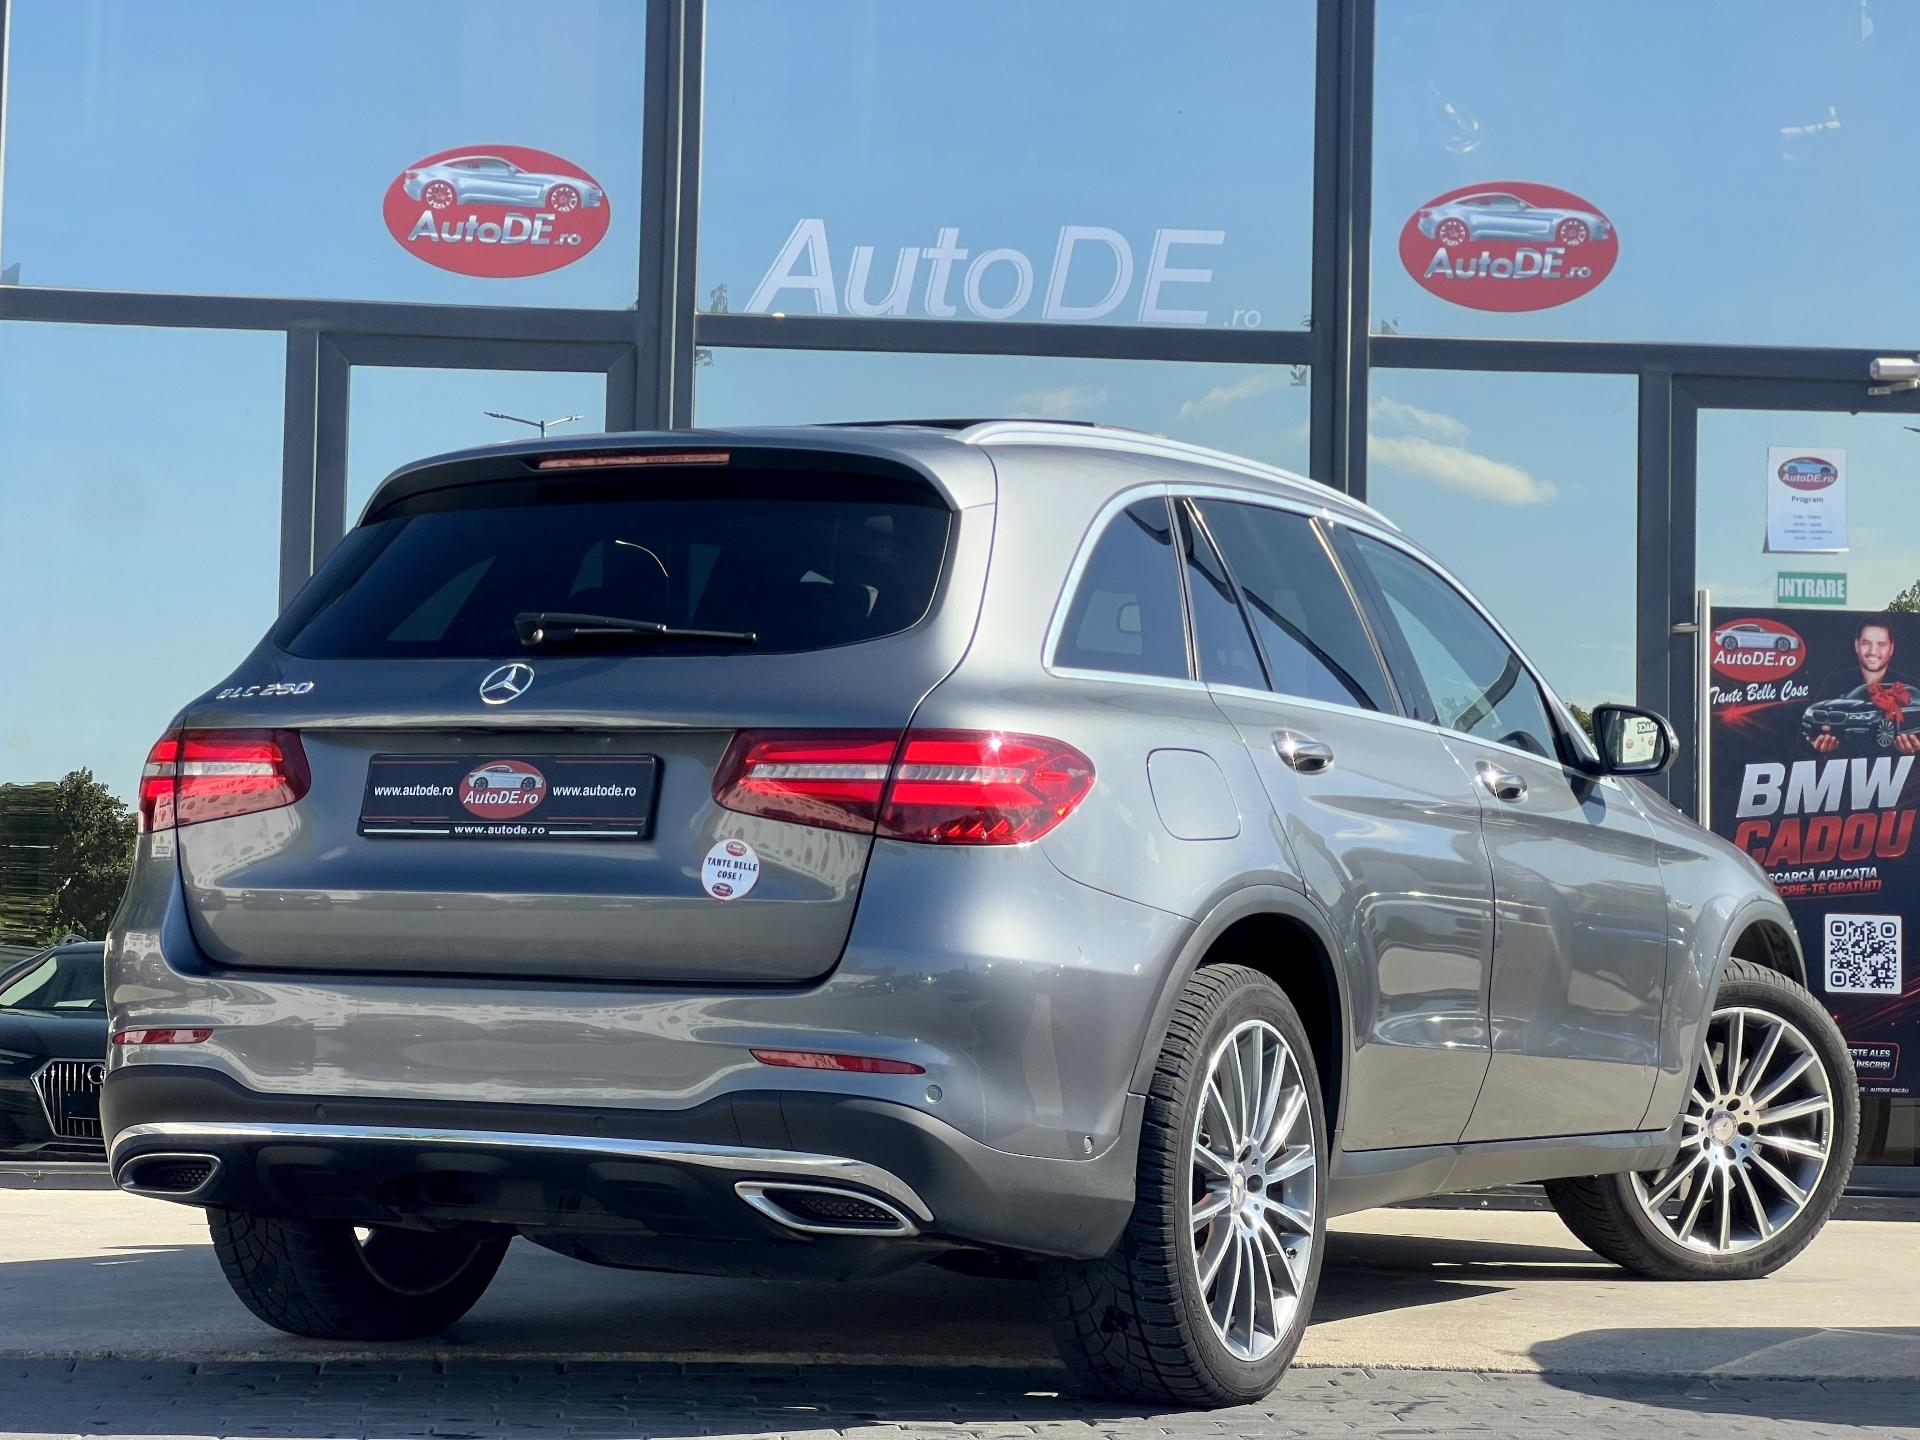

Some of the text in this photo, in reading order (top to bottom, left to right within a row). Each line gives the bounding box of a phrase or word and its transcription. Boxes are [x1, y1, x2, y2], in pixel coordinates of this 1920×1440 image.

[408, 210, 582, 246] AutoDE.ro
[1424, 247, 1591, 279] AutoDE.ro
[1782, 473, 1834, 483] AutoDE.ro
[1791, 495, 1824, 504] Program
[1778, 578, 1845, 599] INTRARE
[1714, 650, 1797, 667] AutoDE.ro
[259, 681, 315, 696] 250
[1710, 679, 1809, 704] Tante Belle Cose
[374, 784, 637, 805] www.autode.ro AutoDE.ro www.autode.ro
[1736, 755, 1916, 818] BMW
[454, 824, 546, 836] www.autode.ro
[1733, 809, 1917, 868] CADOU
[707, 857, 759, 872] TANTE BELLE
[717, 870, 737, 880] COSE
[1768, 868, 1815, 884] SCARCĂ
[1775, 883, 1826, 897] SCRIE-TE
[1869, 1049, 1890, 1057] ALES
